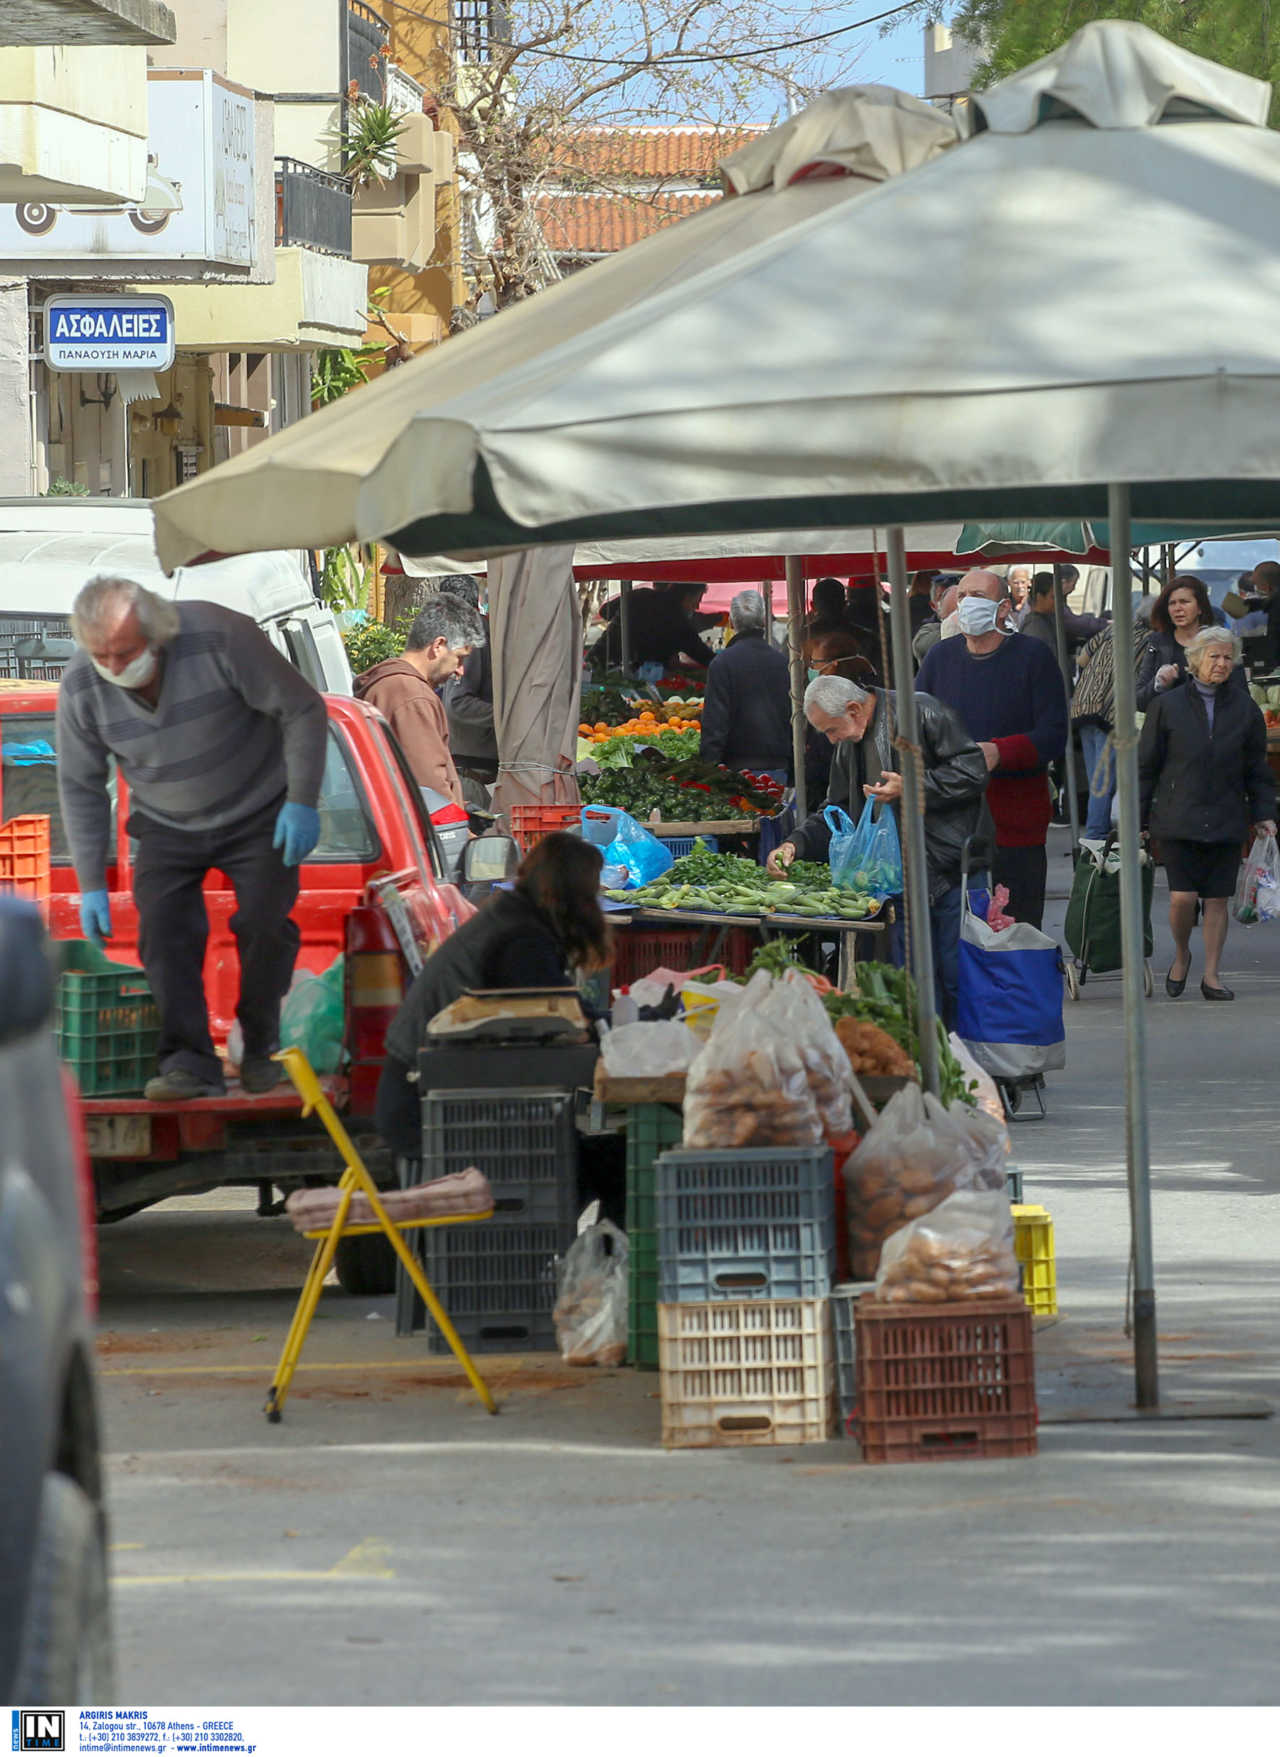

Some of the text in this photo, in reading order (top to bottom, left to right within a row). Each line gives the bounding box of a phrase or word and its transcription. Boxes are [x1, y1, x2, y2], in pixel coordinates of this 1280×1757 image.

[56, 315, 160, 337] ΑΣΦΑΛΕΙΕΣ
[58, 350, 157, 360] ΠΑΝΑΟΥΣΗ ΜΑΡΙΑ
